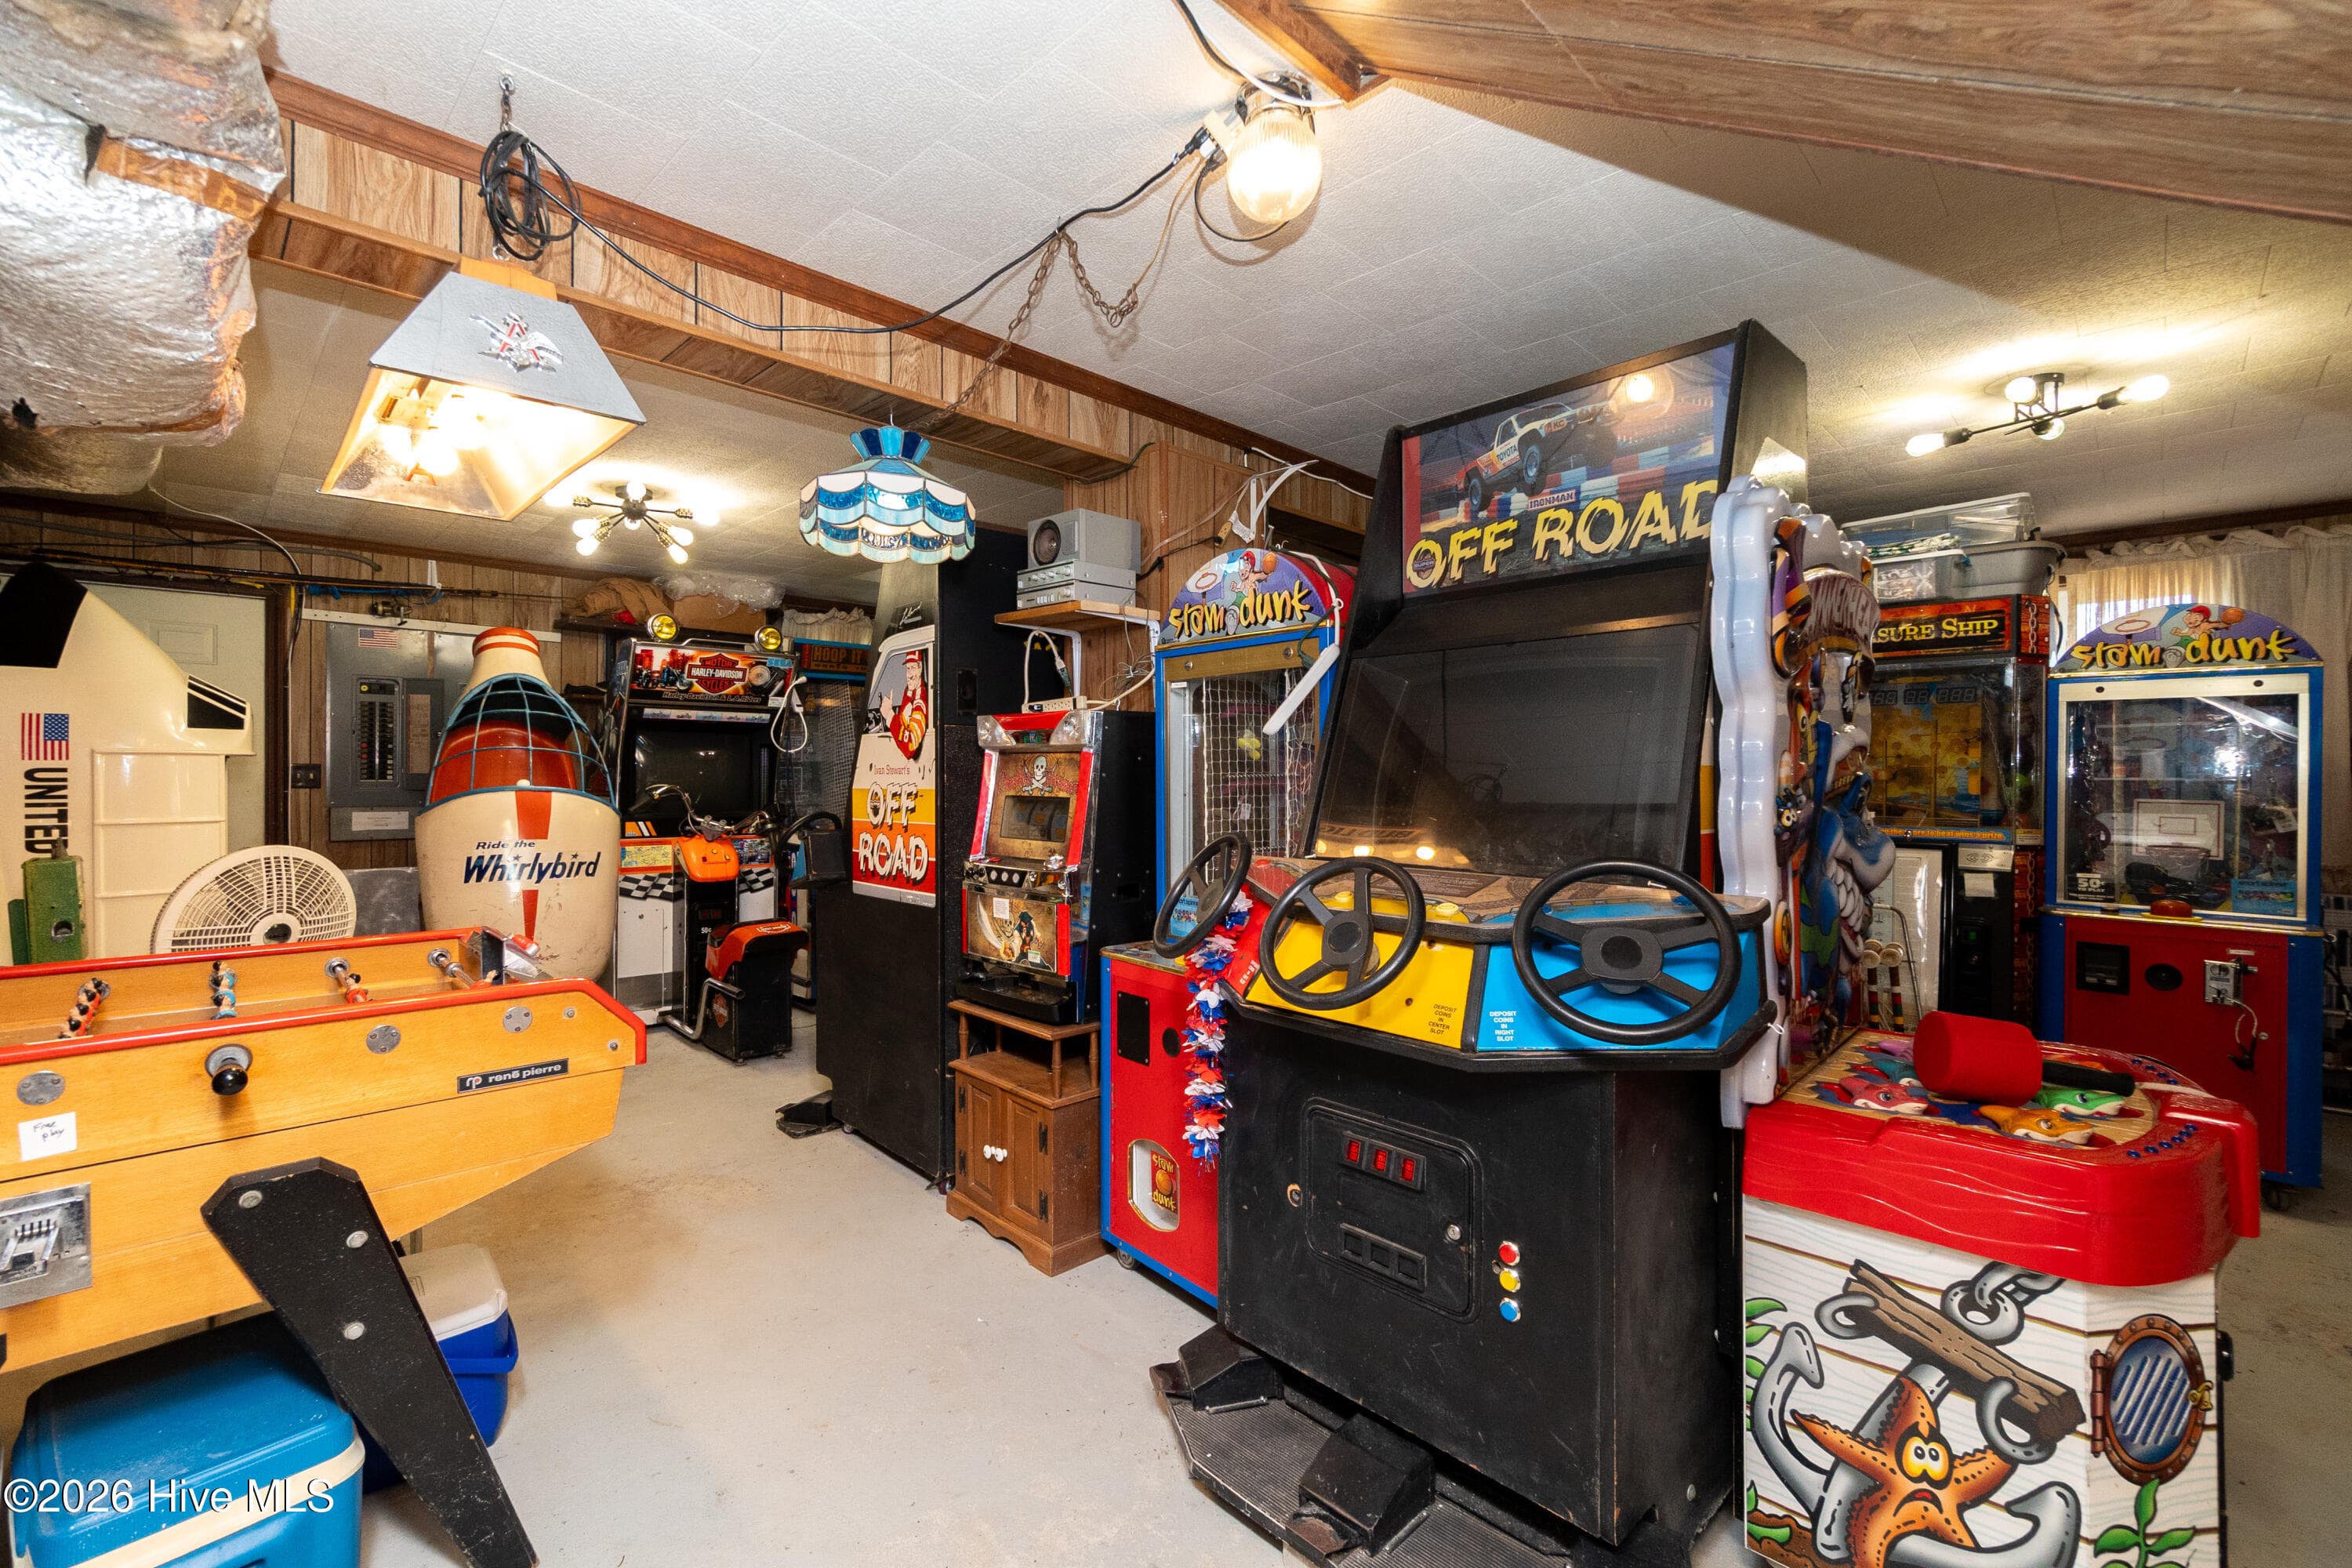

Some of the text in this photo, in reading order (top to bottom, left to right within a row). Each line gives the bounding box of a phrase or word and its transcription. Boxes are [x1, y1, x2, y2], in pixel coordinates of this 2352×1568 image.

[1497, 445, 1518, 461] TOYOTA
[1530, 493, 1573, 509] IRONMAN
[1406, 480, 1719, 590] OFF ROAD
[1240, 579, 1311, 628] dunk
[1872, 618, 1998, 643] SURE SHIP
[2186, 630, 2295, 663] dunk
[704, 656, 735, 666] MOTOR
[691, 667, 744, 679] HARLEY-DAVIDSON
[874, 765, 885, 775] Ivan
[24, 768, 68, 854] UNITED
[866, 782, 918, 831] OFF
[476, 841, 509, 850] Ride
[858, 832, 928, 883] ROAD
[464, 851, 601, 884] Whirlybird
[1433, 1004, 1457, 1012] DEPOSIT
[1428, 1021, 1450, 1030] CENTER
[522, 1064, 562, 1078] pierre
